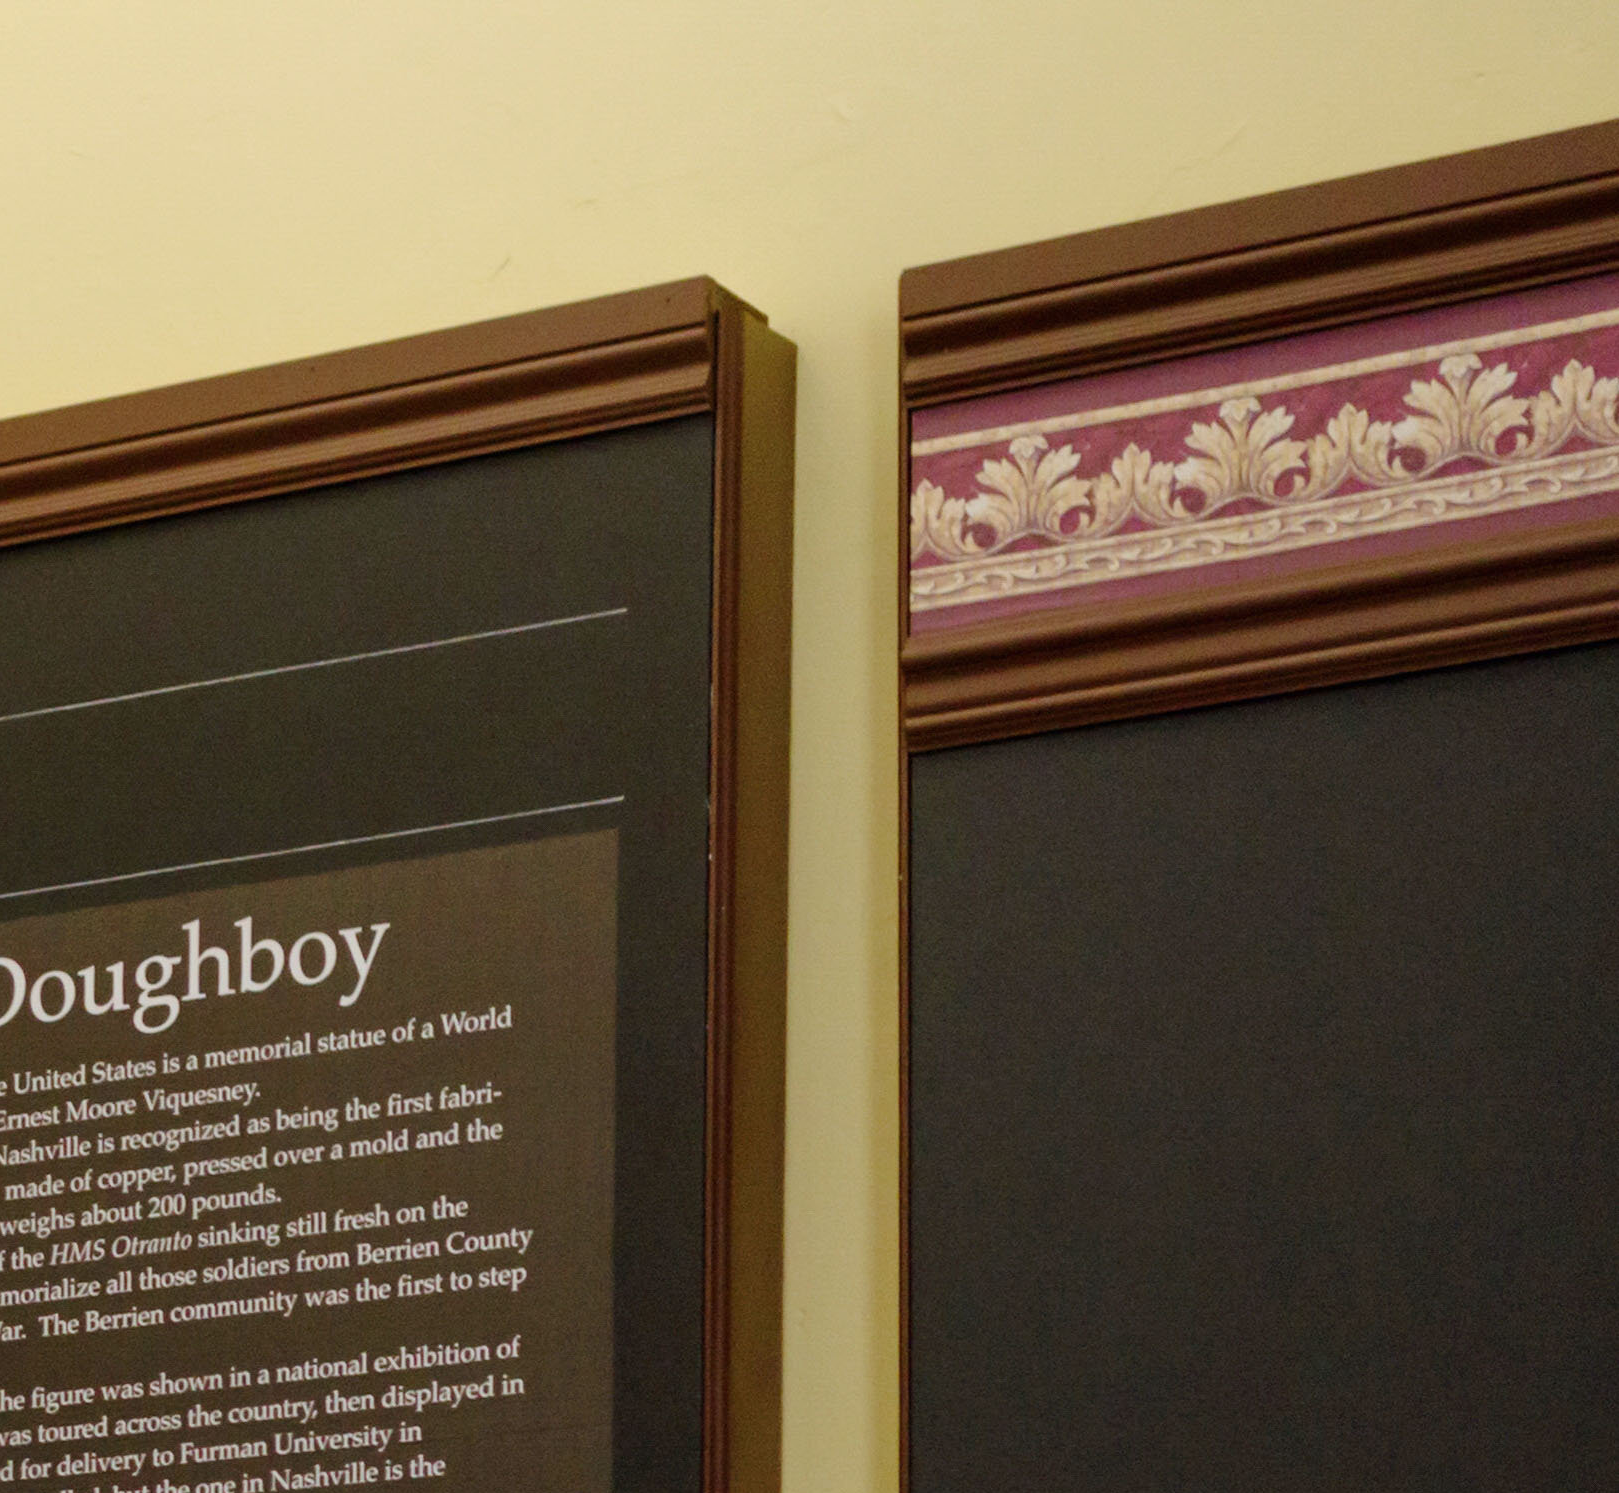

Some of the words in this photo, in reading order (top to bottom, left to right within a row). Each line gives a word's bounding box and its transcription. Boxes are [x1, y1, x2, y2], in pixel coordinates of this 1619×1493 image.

[12, 1062, 87, 1095] United
[90, 1058, 157, 1085] States
[160, 1051, 181, 1075] is
[184, 1053, 199, 1072] a
[203, 1030, 312, 1069] memorial
[315, 1027, 387, 1054] statue
[389, 1015, 417, 1044] of
[419, 1020, 435, 1040] a
[439, 1002, 513, 1036] World
[64, 1097, 138, 1123] Moore
[141, 1081, 261, 1115] Viquesney.
